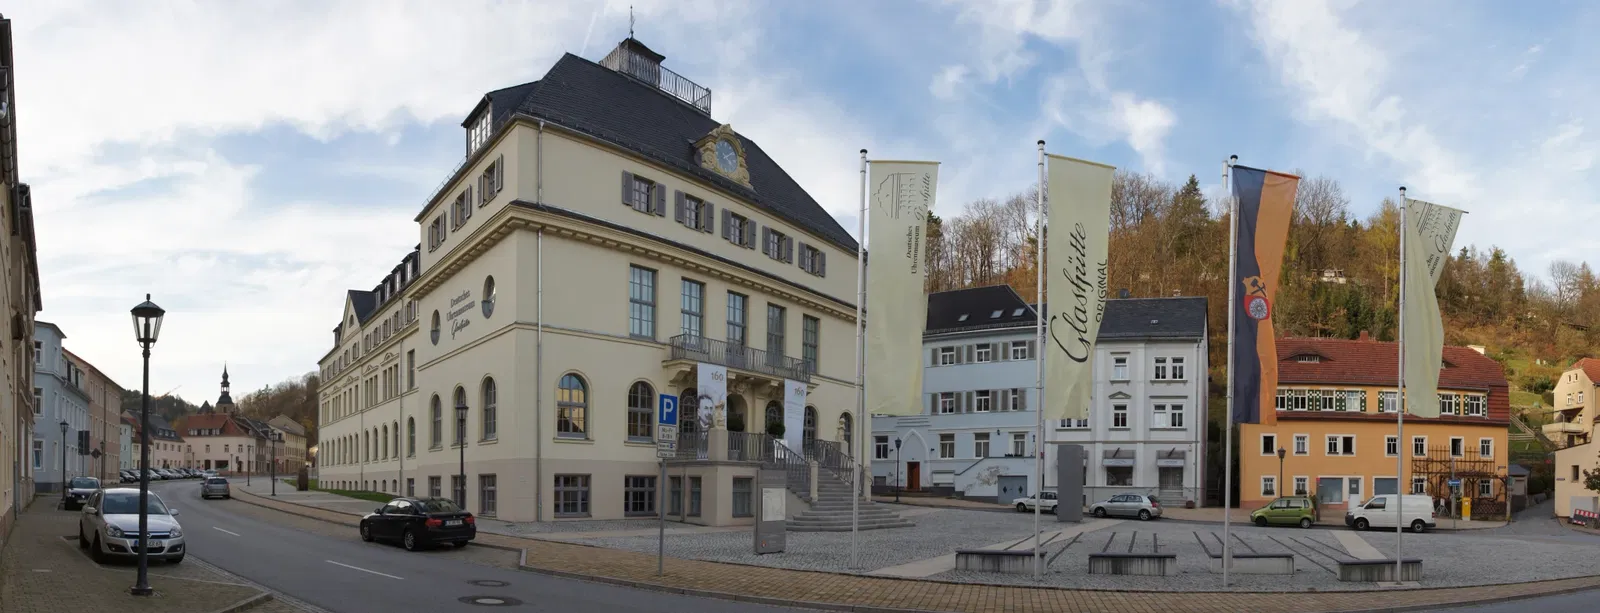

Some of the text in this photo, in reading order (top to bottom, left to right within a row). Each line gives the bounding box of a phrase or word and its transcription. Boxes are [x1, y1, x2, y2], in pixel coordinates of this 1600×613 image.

[911, 225, 920, 275] Uhrenmuseum
[1050, 222, 1093, 362] Glashütte
[1095, 259, 1108, 323] ORIGINAL
[711, 371, 724, 382] 160
[794, 386, 805, 397] 160
[663, 398, 674, 421] P
